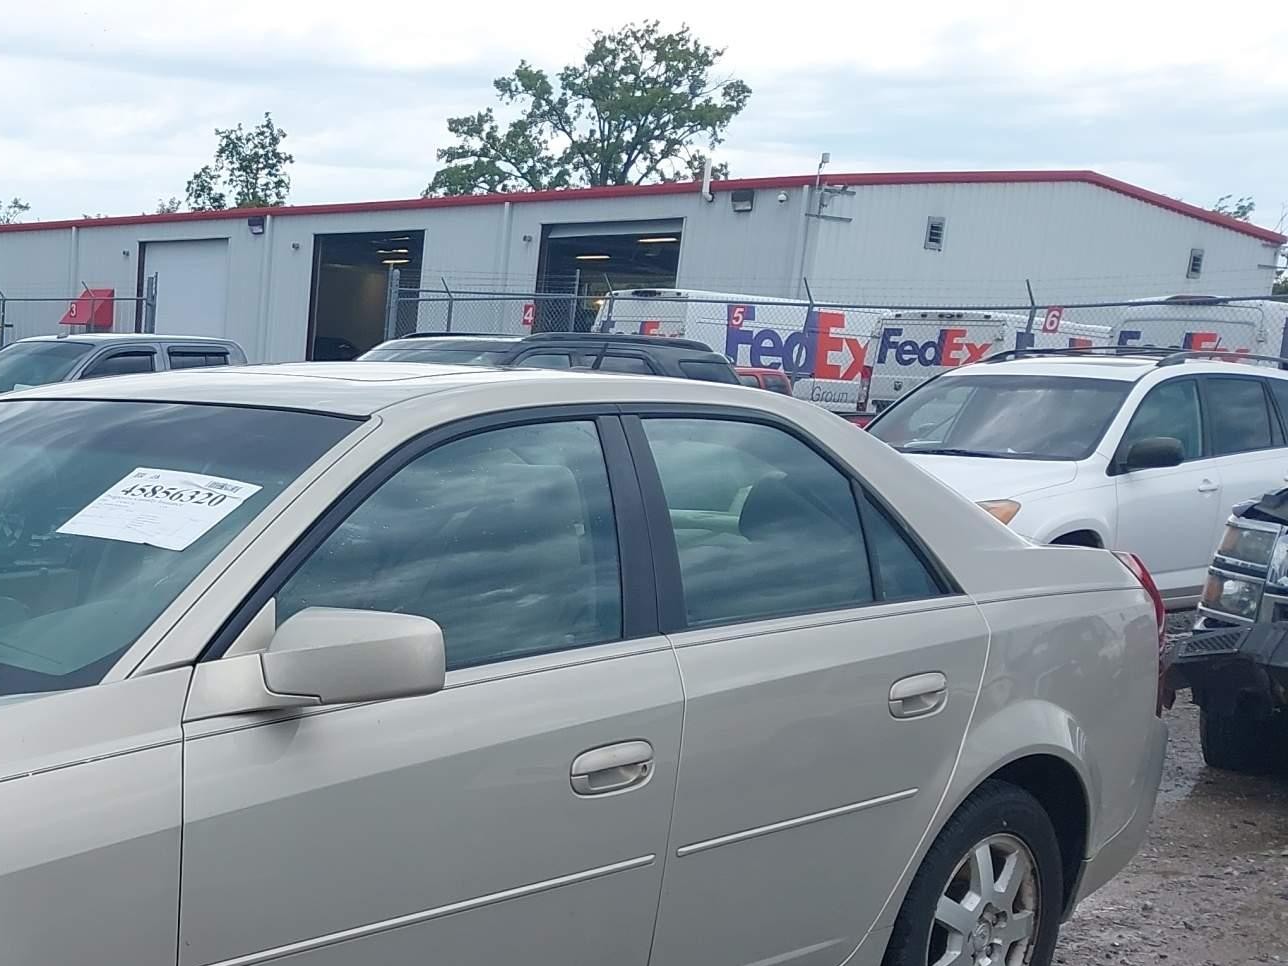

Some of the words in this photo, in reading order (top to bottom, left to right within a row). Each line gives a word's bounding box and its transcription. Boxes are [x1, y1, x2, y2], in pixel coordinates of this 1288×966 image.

[70, 303, 77, 317] 3
[523, 306, 534, 323] 4
[732, 306, 745, 325] 5
[1045, 310, 1060, 330] 6
[876, 327, 993, 368] FedEx
[120, 483, 227, 507] 45856320
